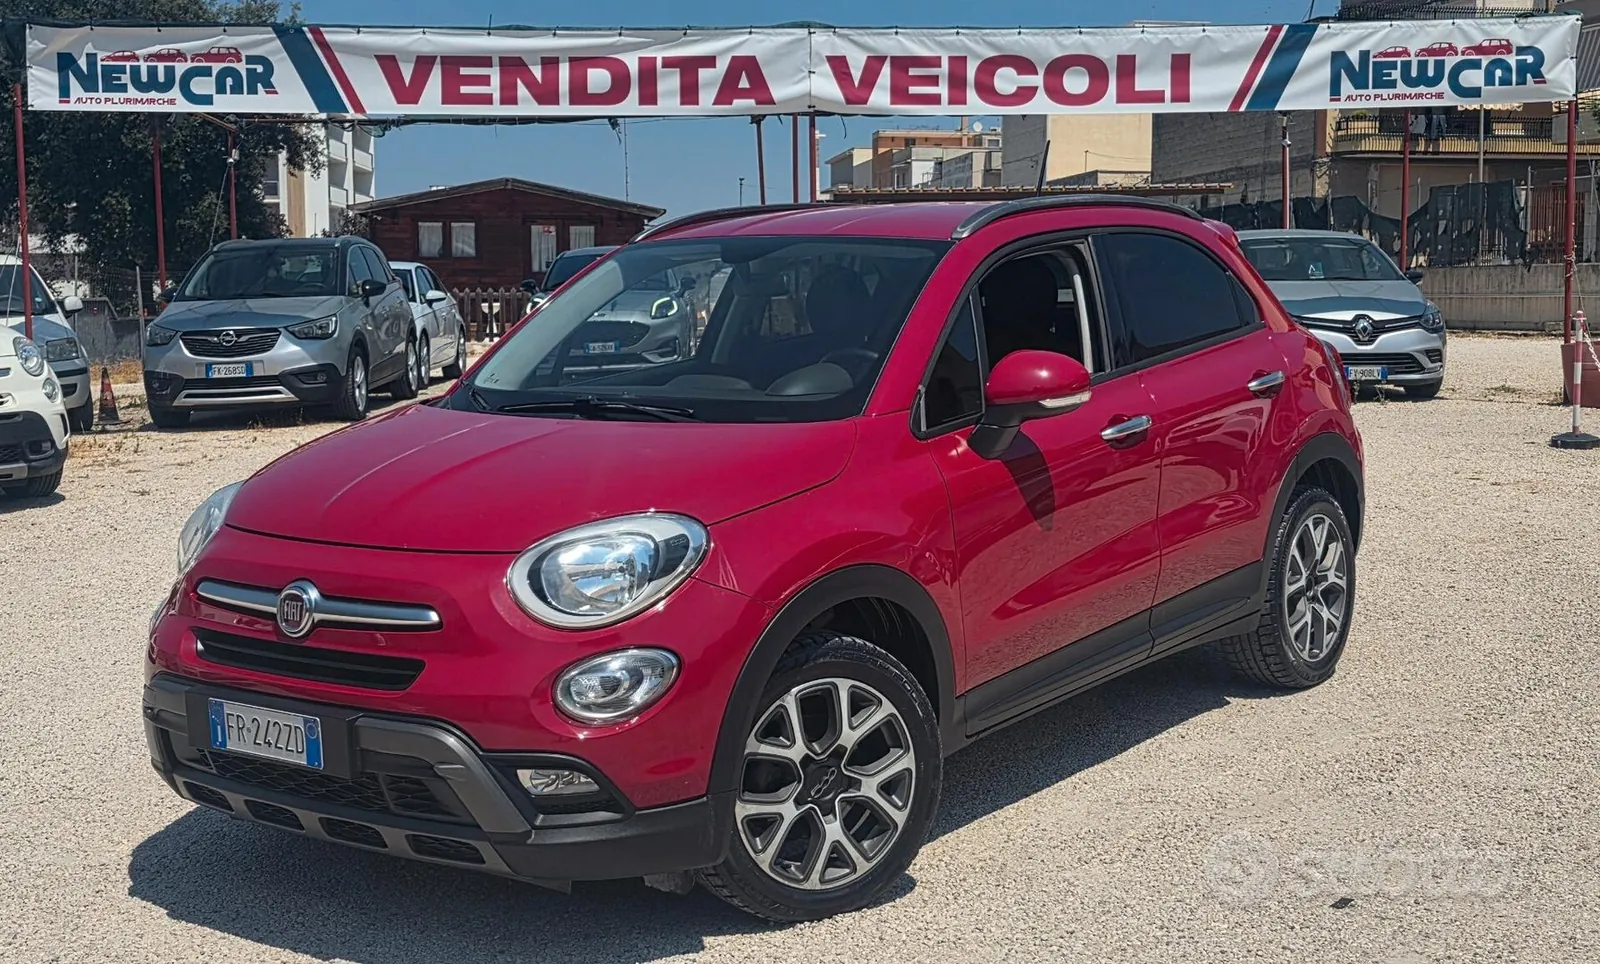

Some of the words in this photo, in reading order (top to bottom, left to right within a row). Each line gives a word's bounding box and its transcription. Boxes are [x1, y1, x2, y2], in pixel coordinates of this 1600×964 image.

[374, 54, 777, 106] VENDITA
[825, 53, 1192, 107] VEICOLI
[104, 97, 177, 106] PLURIMARCHE
[1344, 94, 1371, 102] AUTO
[1373, 92, 1445, 101] PLURIMARCHE
[284, 600, 303, 621] FIAT
